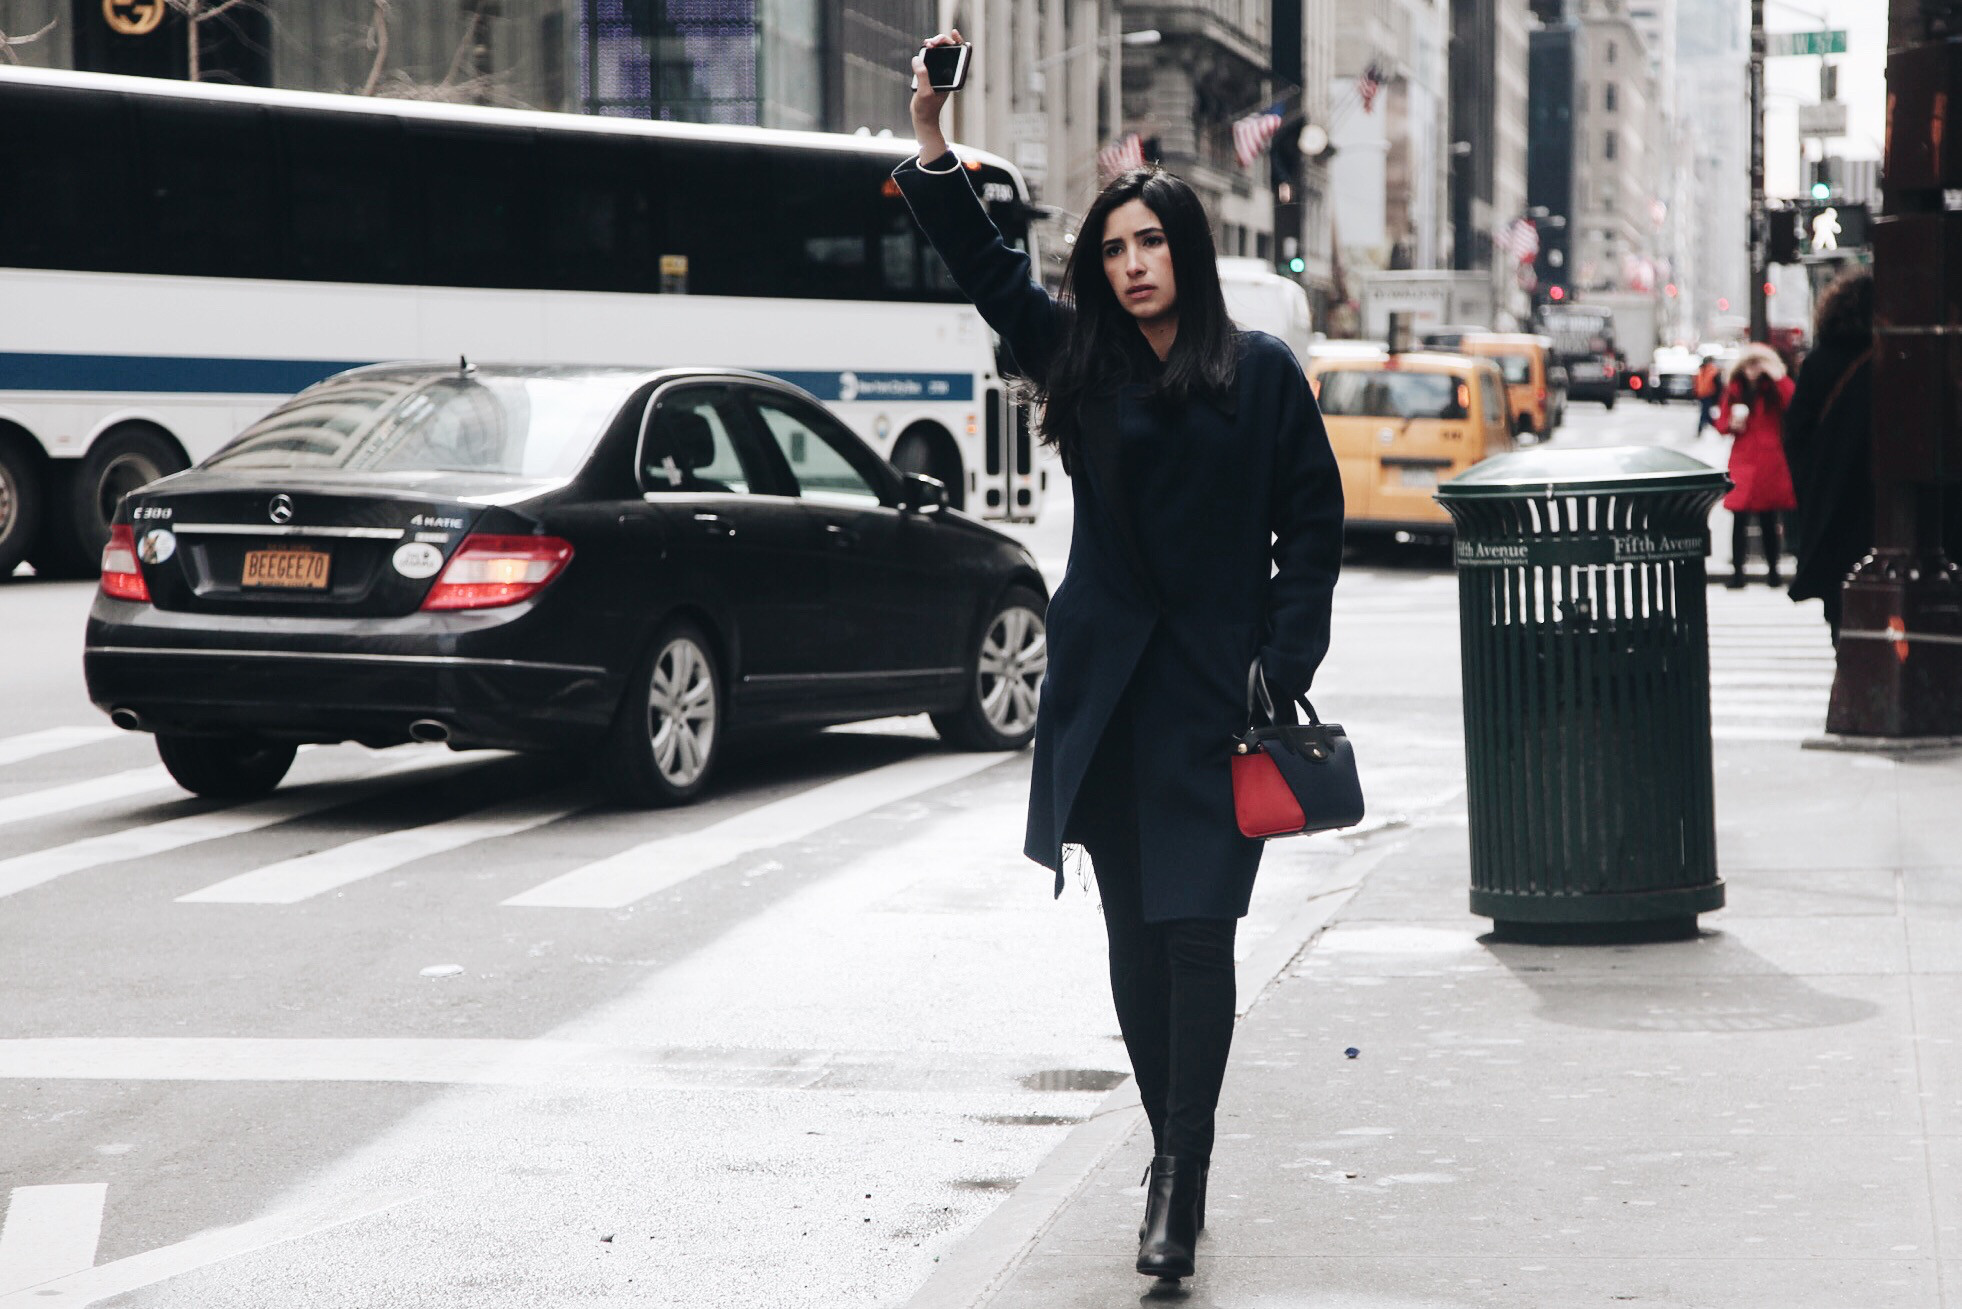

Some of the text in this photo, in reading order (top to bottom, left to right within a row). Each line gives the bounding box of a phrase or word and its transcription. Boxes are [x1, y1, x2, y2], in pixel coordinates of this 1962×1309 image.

[1476, 542, 1528, 557] Avenue
[1616, 534, 1703, 553] Fifth Avenue
[248, 552, 324, 579] BEEGEE70
